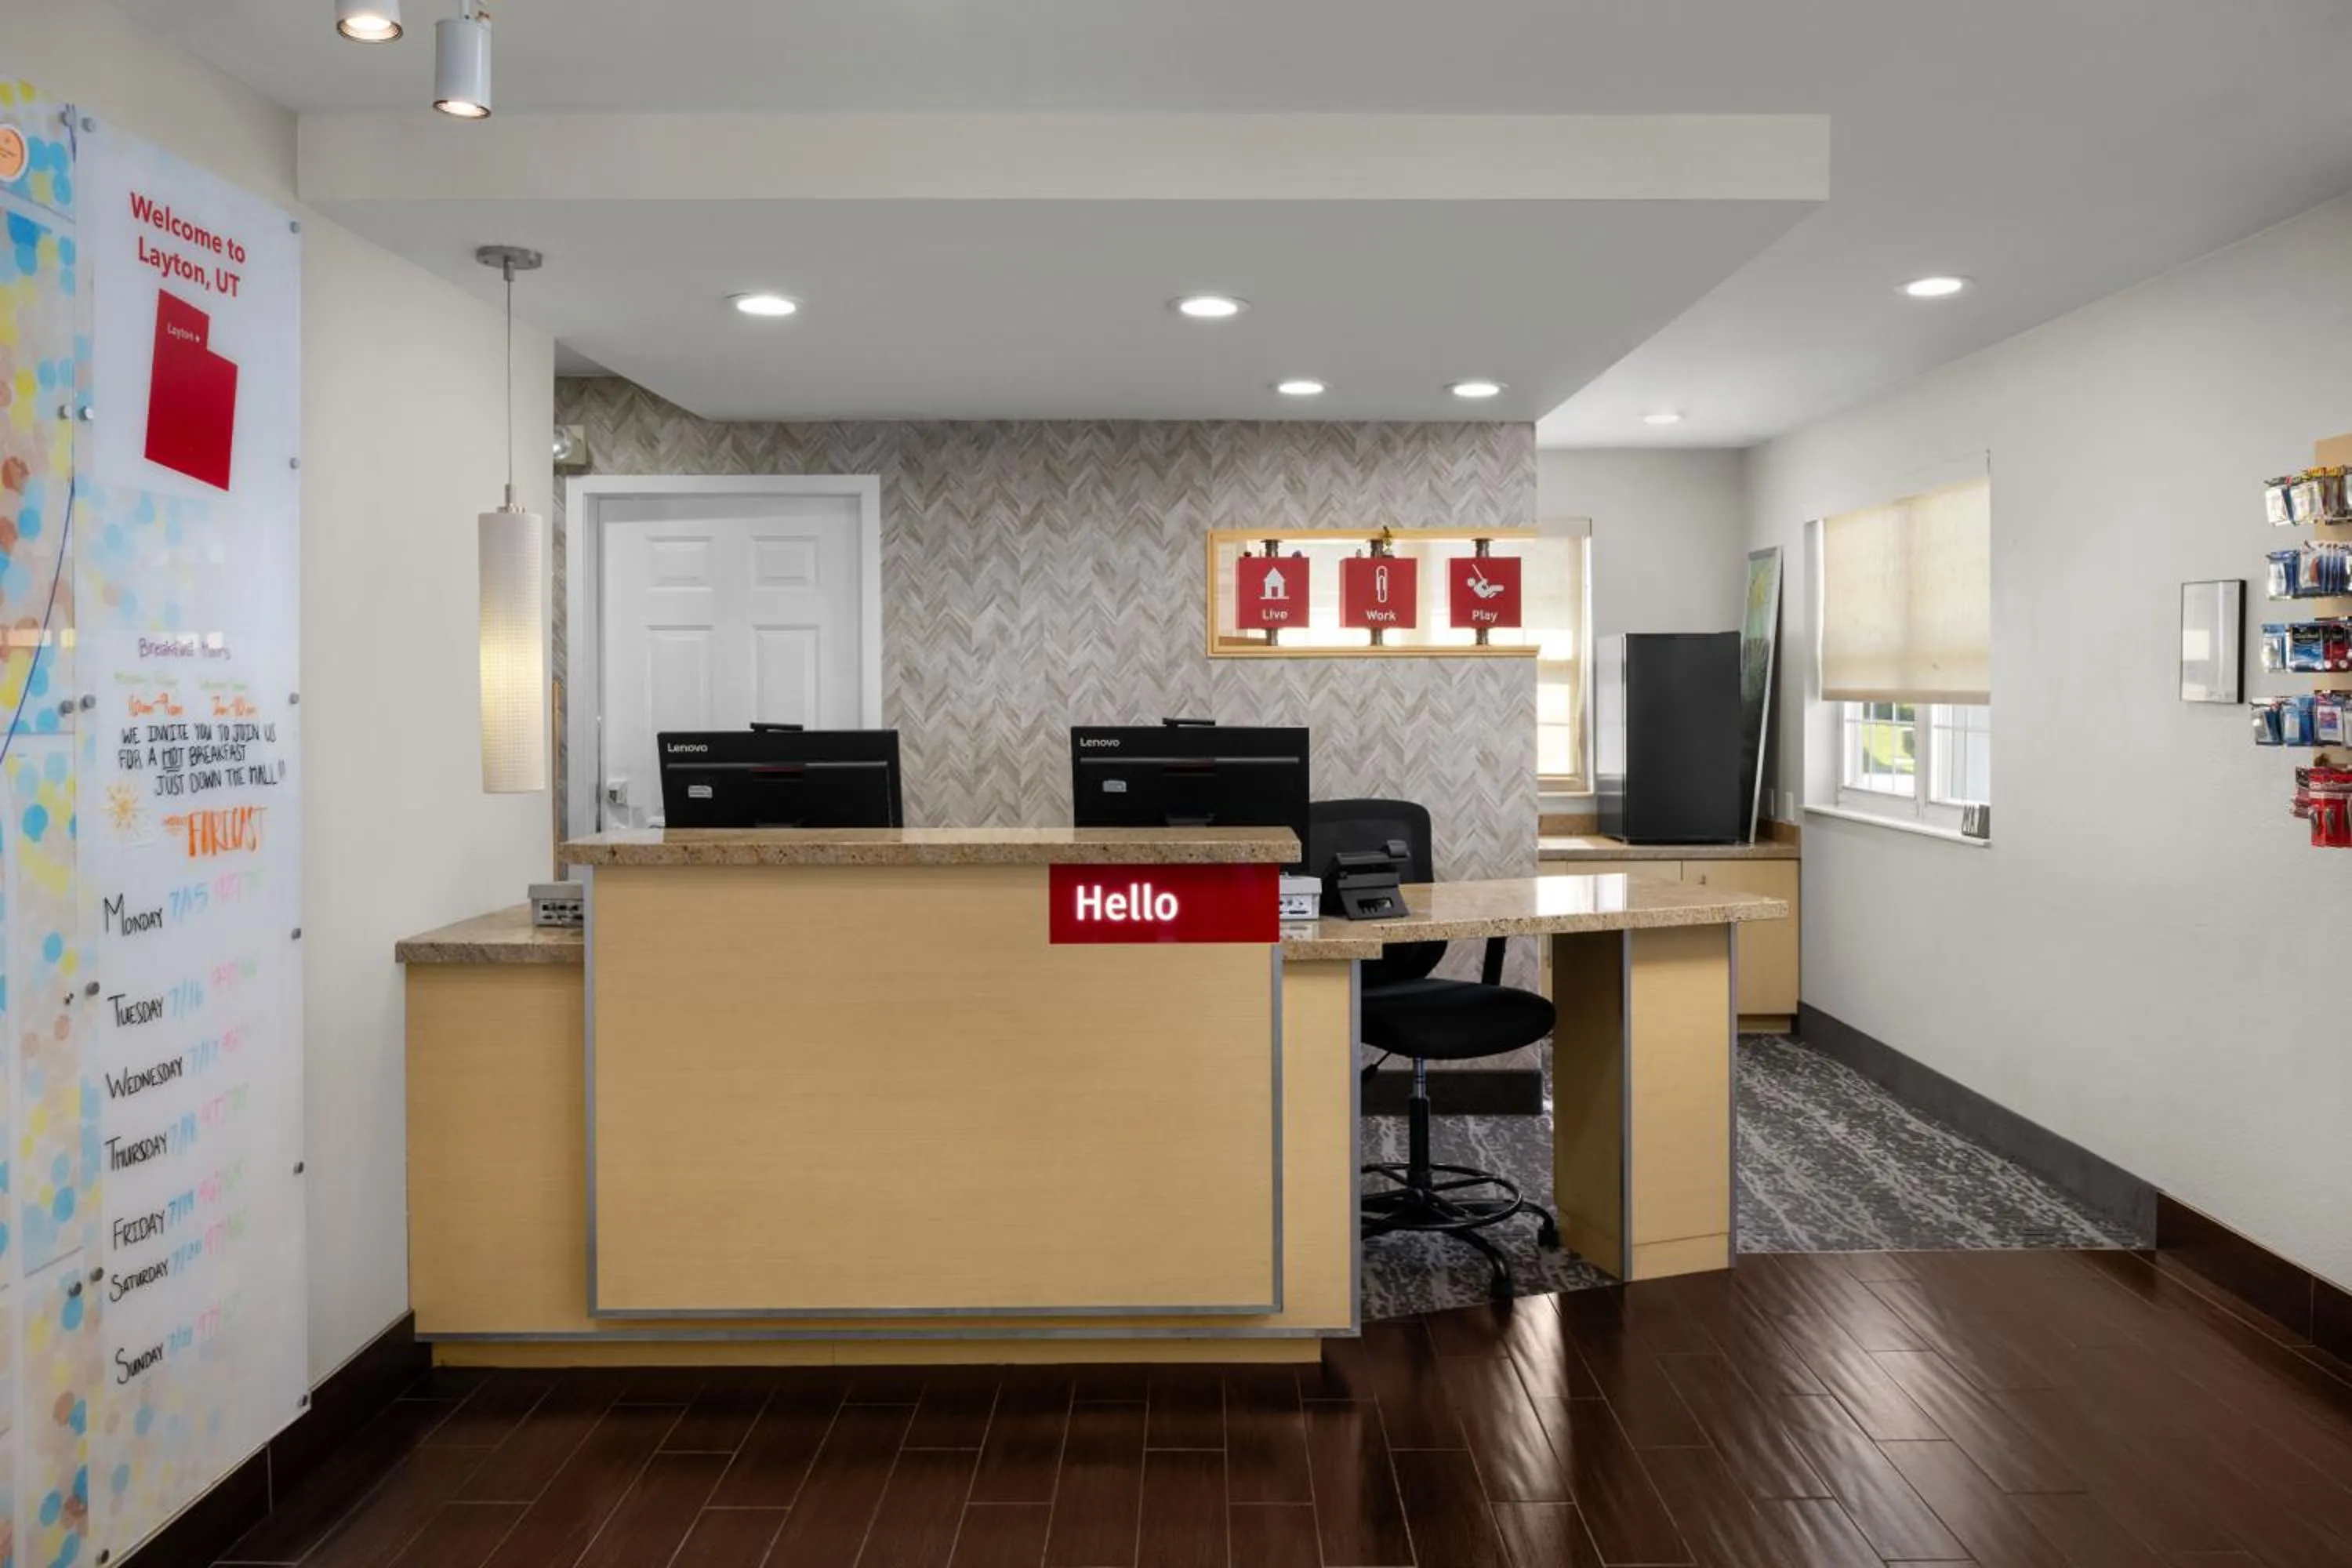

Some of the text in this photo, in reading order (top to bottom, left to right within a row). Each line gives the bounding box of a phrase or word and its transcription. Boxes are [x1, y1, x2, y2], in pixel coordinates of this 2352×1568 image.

[131, 192, 245, 263] Welcome to
[139, 236, 240, 296] Layton, UT
[167, 322, 194, 341] Layton
[1262, 609, 1288, 620] Live
[1367, 609, 1396, 622] Work
[1472, 609, 1497, 623] Play
[121, 727, 140, 744] WE
[217, 724, 230, 741] TO
[233, 724, 260, 742] JOIN
[1080, 737, 1120, 747] Lenovo
[118, 750, 143, 769] FOR
[148, 746, 157, 766] A
[189, 745, 246, 766] BREAKFAST
[667, 743, 708, 753] Lenovo
[154, 774, 184, 796] JUST
[189, 769, 222, 793] DOWN
[226, 767, 245, 786] THE
[1076, 883, 1178, 921] Hello
[113, 1210, 165, 1250] FRIDAY
